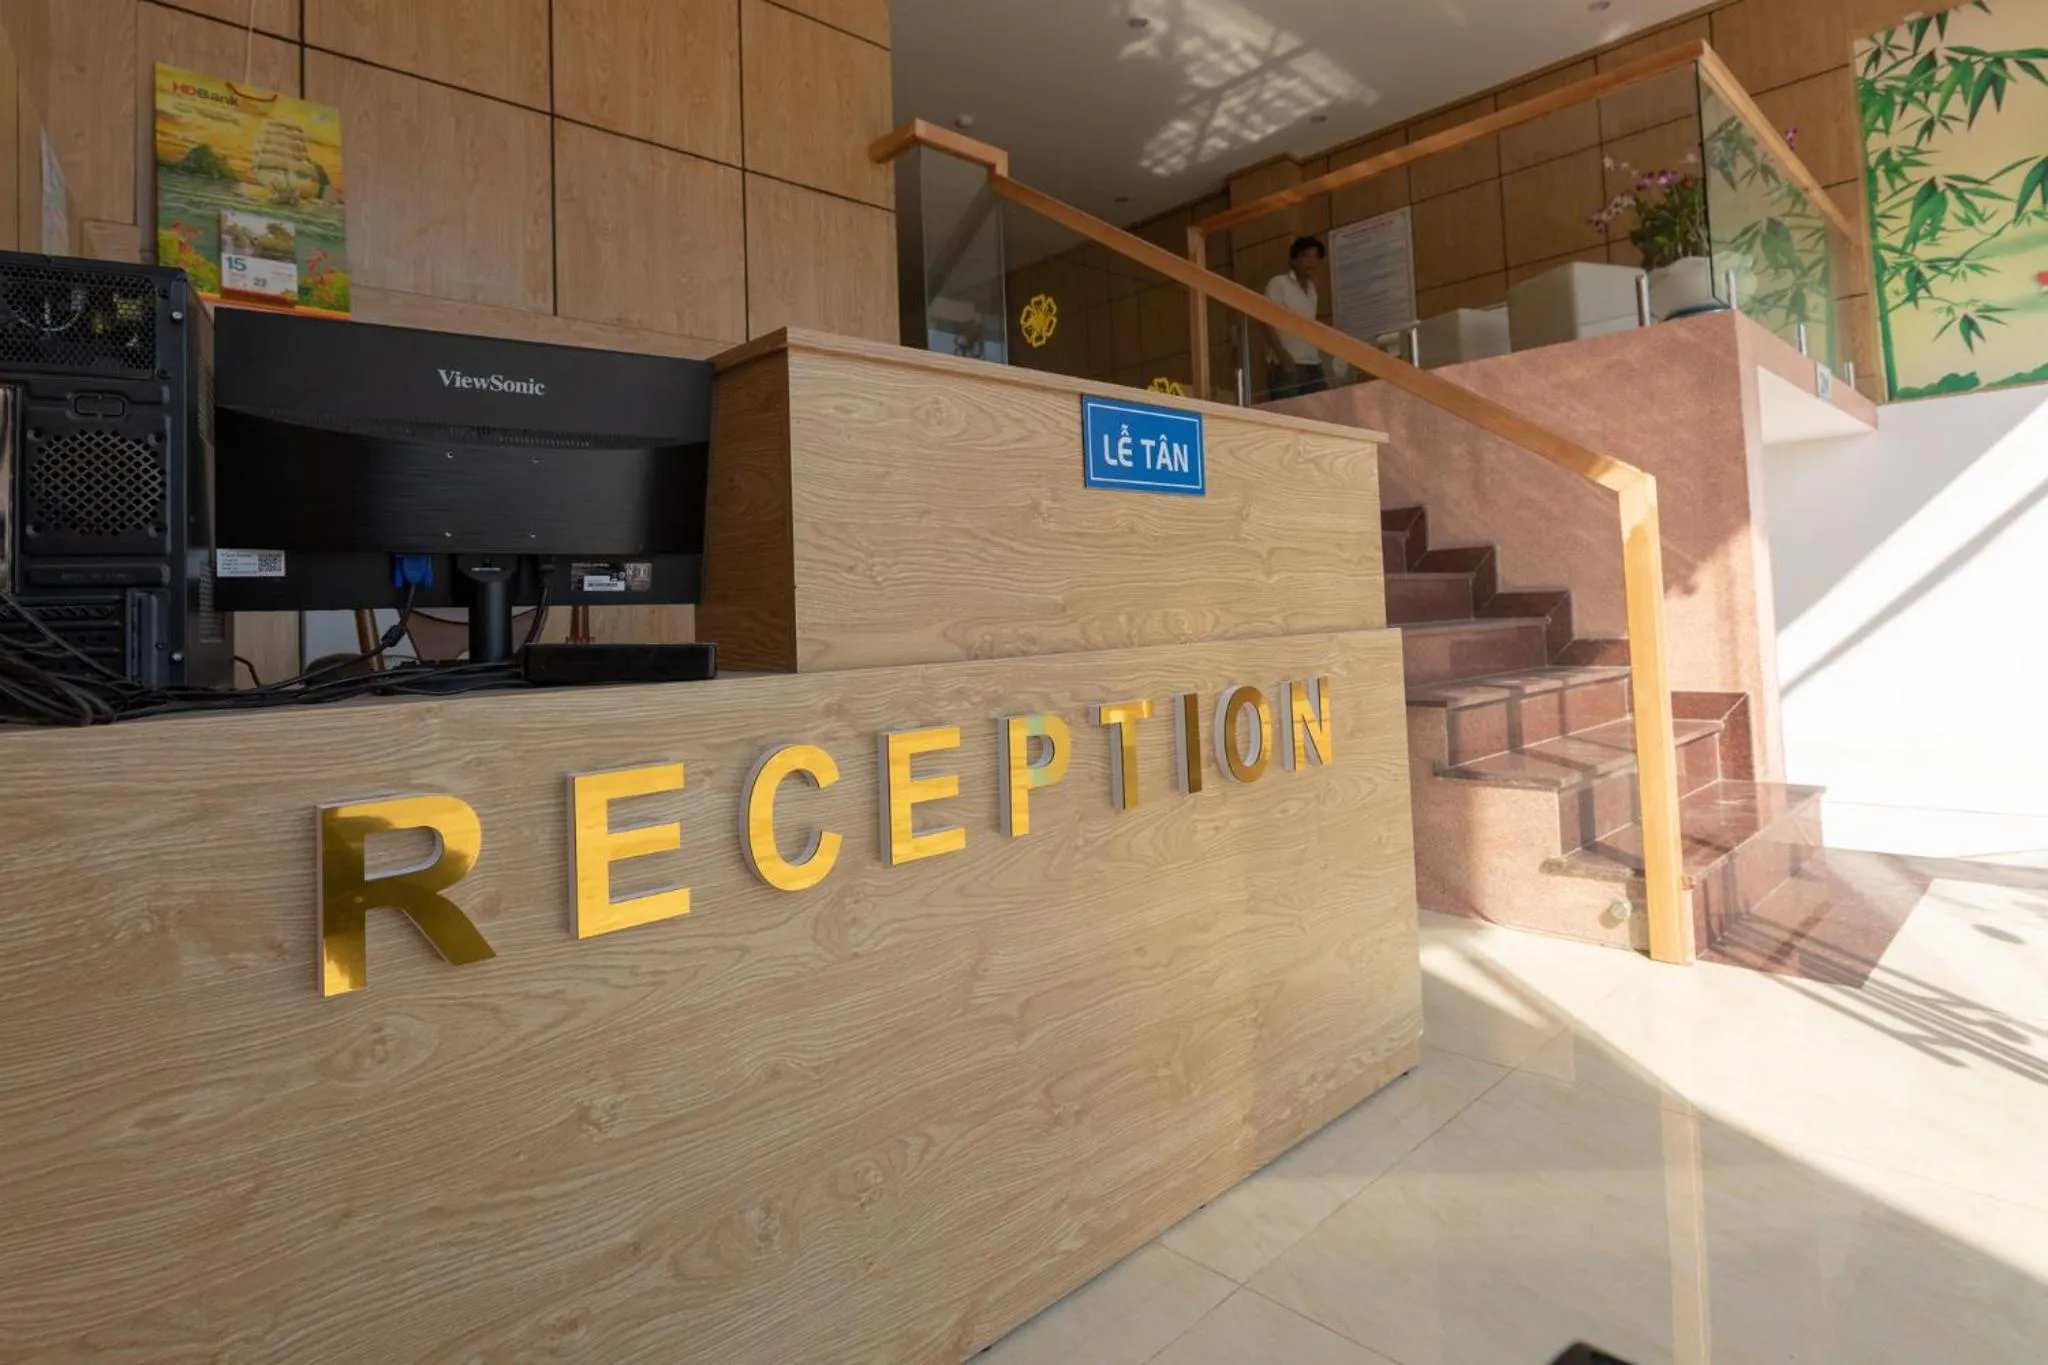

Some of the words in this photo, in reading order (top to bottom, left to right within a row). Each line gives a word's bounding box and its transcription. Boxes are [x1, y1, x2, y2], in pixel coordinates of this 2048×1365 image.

[172, 81, 239, 107] HDBank
[225, 255, 247, 272] 15
[437, 367, 546, 396] ViewSonic
[1103, 423, 1134, 468] LỄ
[1140, 434, 1189, 473] TÂN
[316, 675, 1334, 998] RECEPTION
